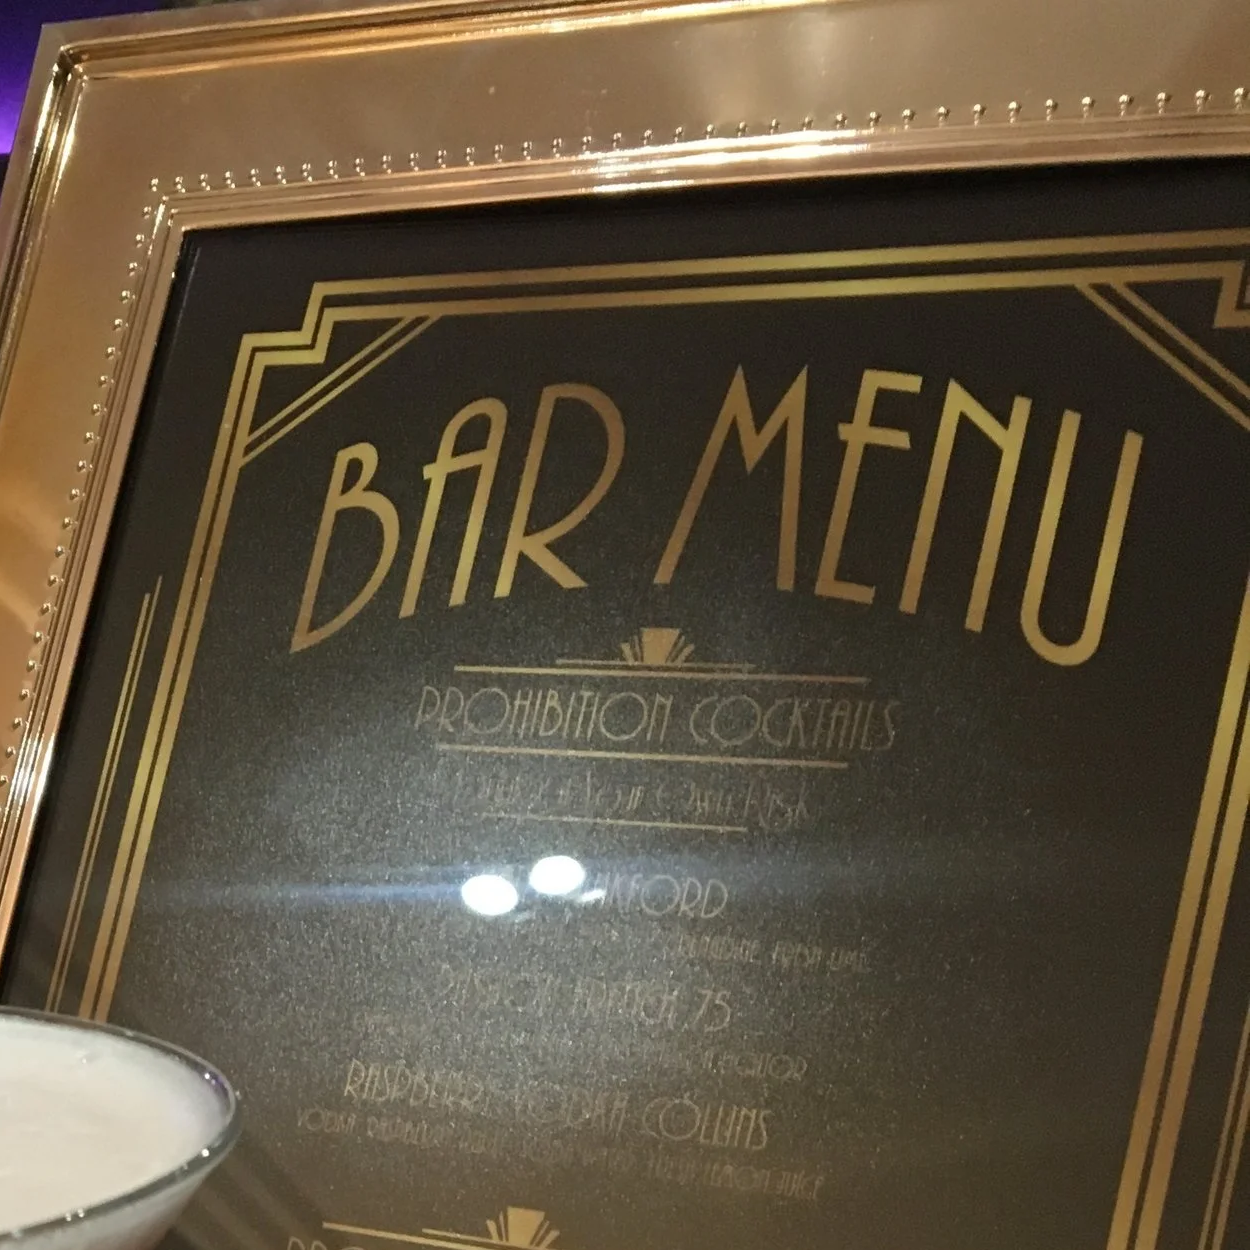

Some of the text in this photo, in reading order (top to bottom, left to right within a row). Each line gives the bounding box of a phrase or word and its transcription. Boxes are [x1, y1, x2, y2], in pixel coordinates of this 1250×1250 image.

[289, 363, 1144, 667] BAR MENU
[414, 685, 900, 752] PROHIBITION COCKTAILS
[642, 1093, 775, 1152] COLLINS
